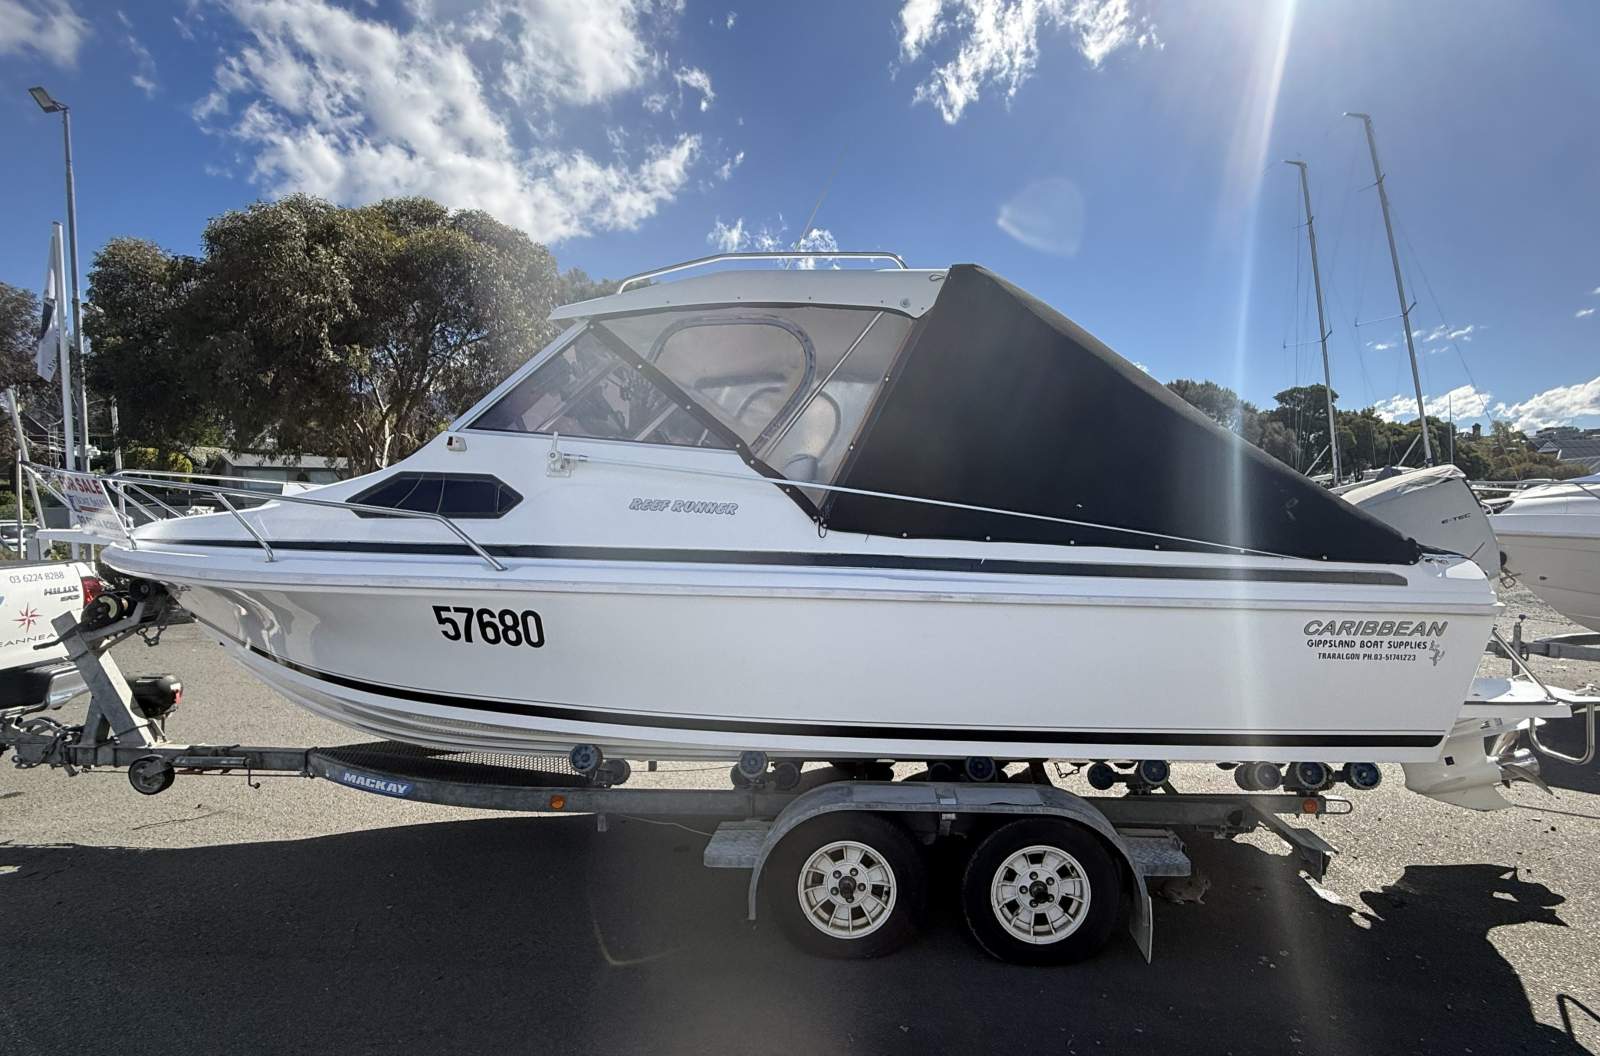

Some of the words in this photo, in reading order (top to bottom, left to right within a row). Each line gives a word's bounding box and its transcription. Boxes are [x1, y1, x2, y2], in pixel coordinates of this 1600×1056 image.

[75, 478, 103, 495] SALE
[629, 498, 671, 512] REEF
[671, 499, 739, 515] RUNNER
[9, 575, 21, 584] 03
[22, 573, 43, 583] 6224
[44, 571, 65, 581] 8288
[43, 585, 79, 596] HILUX
[432, 605, 545, 648] 57680
[1303, 620, 1449, 637] CARIBBEAN
[1306, 639, 1356, 649] GIPPSLAND
[1359, 640, 1385, 649] BOAT
[1387, 640, 1428, 650] SUPPLIES
[1318, 652, 1361, 661] TRARALGON
[343, 772, 409, 794] MACKAY
